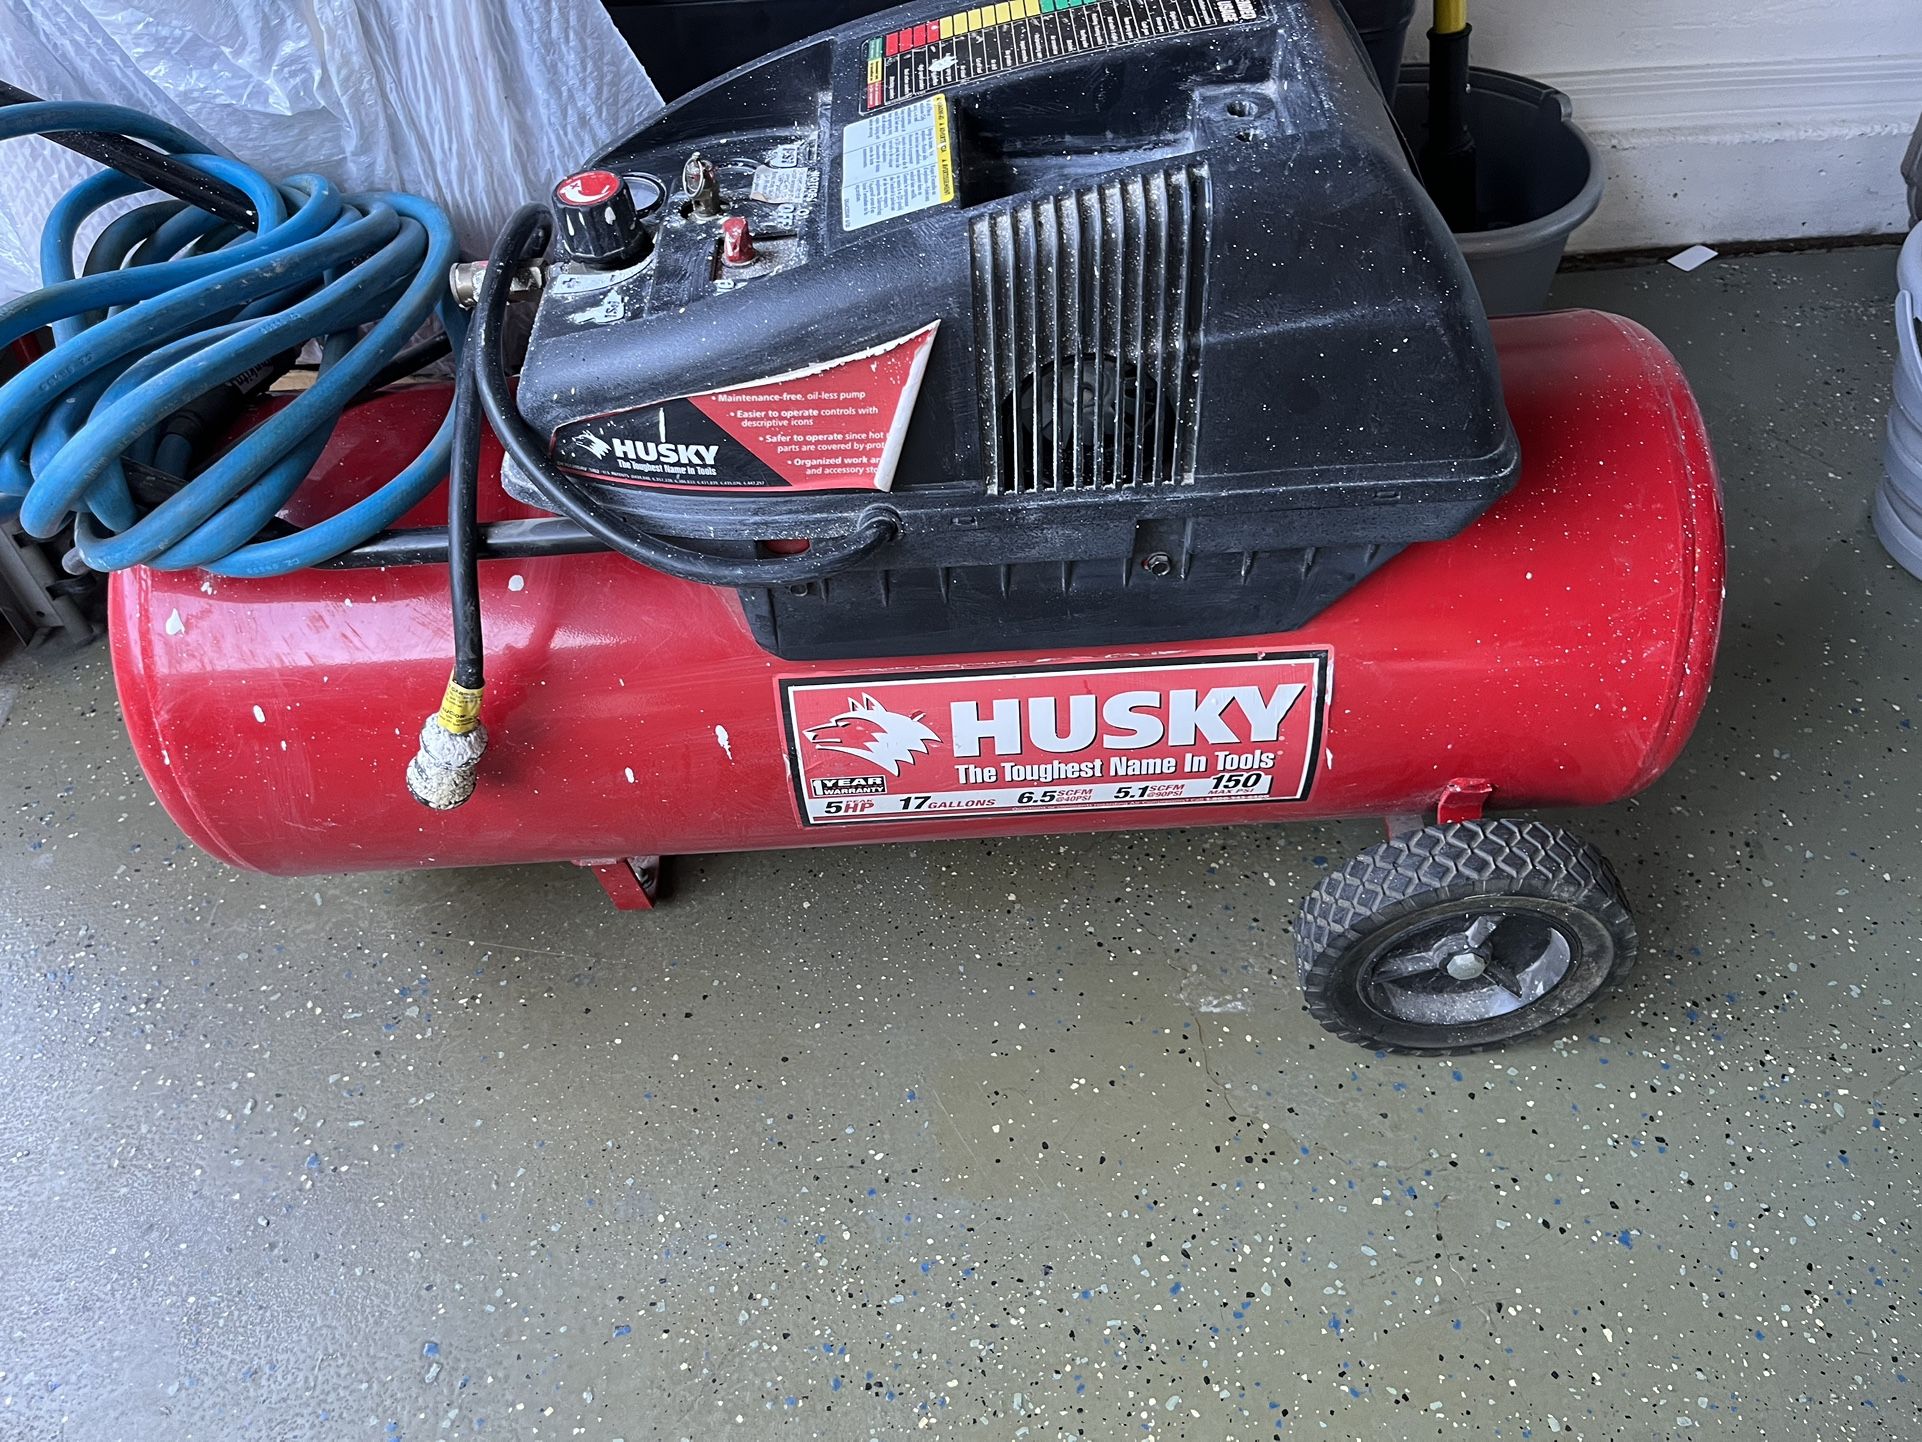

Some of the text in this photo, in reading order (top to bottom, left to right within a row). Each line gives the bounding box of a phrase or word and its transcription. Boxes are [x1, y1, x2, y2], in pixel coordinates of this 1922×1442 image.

[1216, 1, 1239, 22] USAGE
[778, 203, 795, 229] OFF
[718, 391, 866, 402] Maintenance-free, oil-less pump
[736, 406, 879, 419] Easier to operate controls with
[741, 418, 813, 428] descriptive icons
[765, 433, 791, 443] Safer
[793, 434, 804, 442] to
[805, 432, 844, 443] operate
[845, 431, 867, 440] since
[868, 431, 884, 439] hot
[612, 438, 719, 465] HUSKY
[777, 443, 800, 454] parts
[801, 444, 816, 452] are
[817, 442, 852, 451] covered
[617, 459, 717, 476] The Toughest Name In Tools
[793, 456, 842, 467] Organized
[843, 456, 868, 465] work
[805, 466, 878, 476] and accessory sto
[950, 682, 1306, 758] HUSKY
[954, 749, 1275, 784] The Toughest Name In Tools
[812, 777, 883, 796] 1 YEAR
[1210, 772, 1263, 790] 150
[823, 786, 884, 795] WARRANTY
[1017, 788, 1093, 804] 6.5 SCFM
[1114, 784, 1185, 799] 5.1 SCFM
[824, 801, 875, 814] 5 HP
[899, 795, 996, 810] 17 GALLONS
